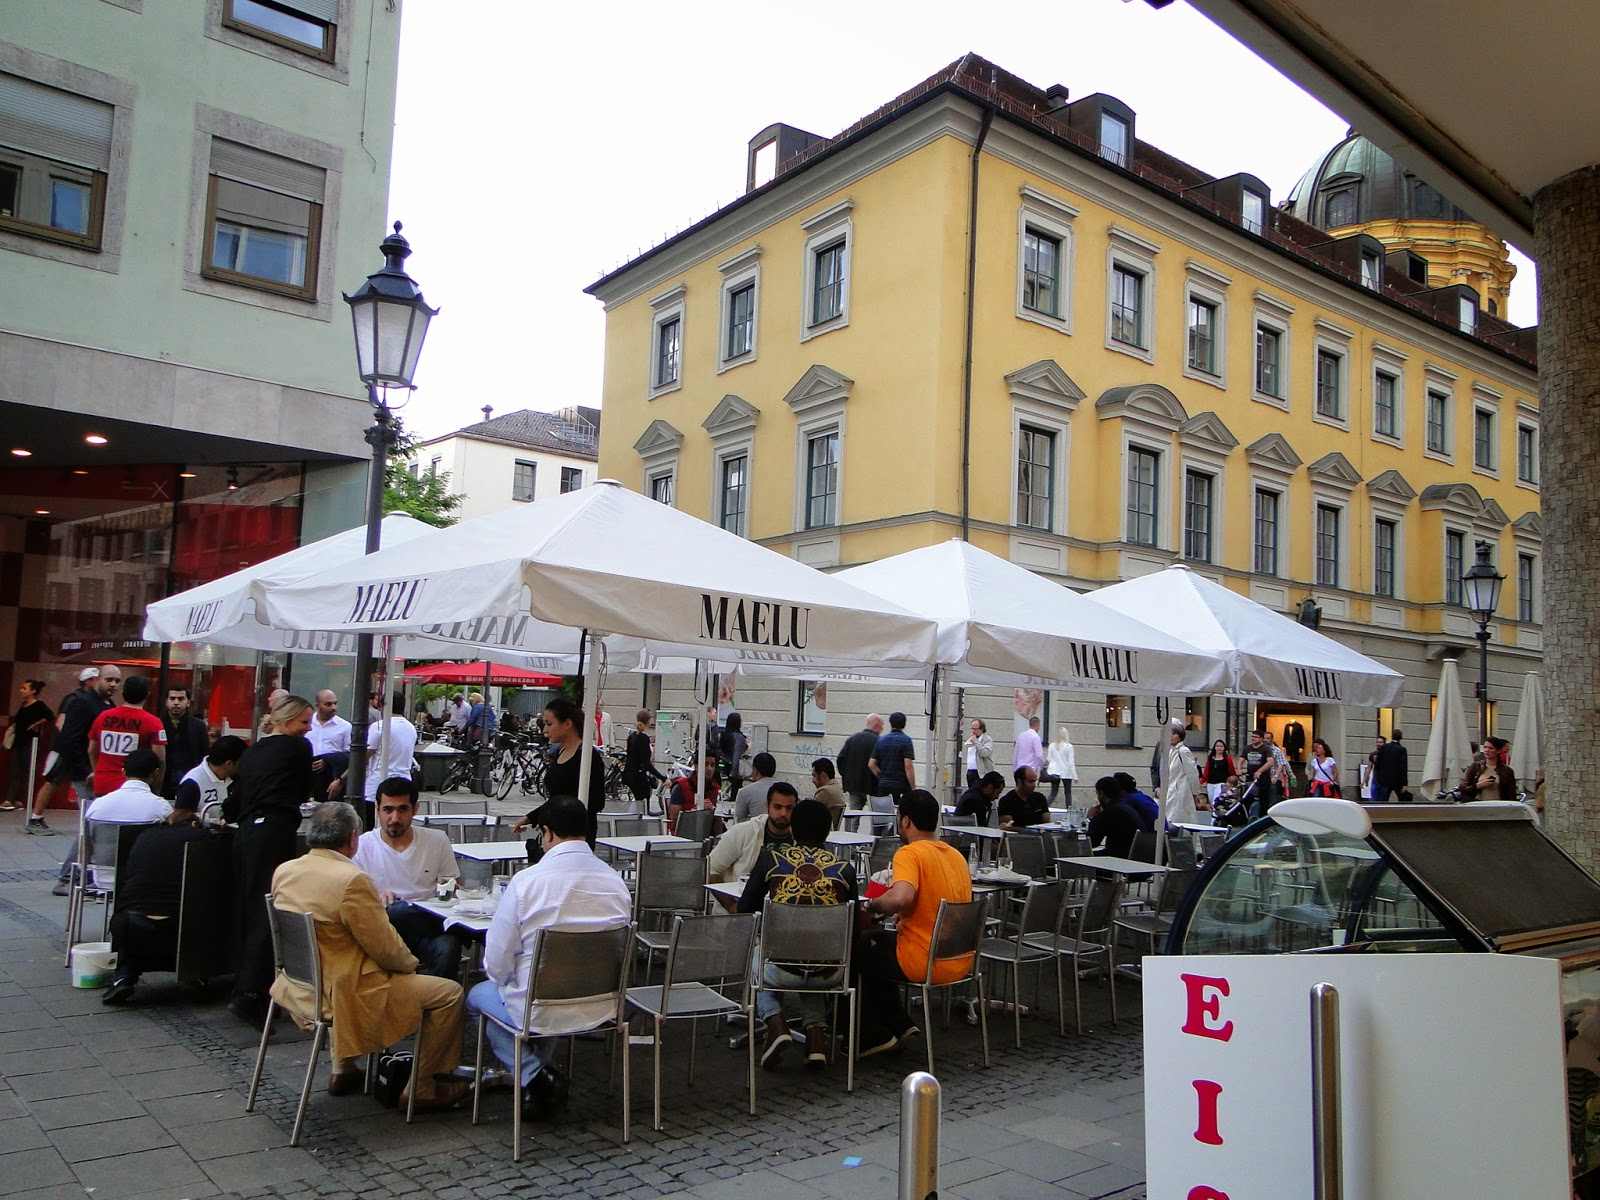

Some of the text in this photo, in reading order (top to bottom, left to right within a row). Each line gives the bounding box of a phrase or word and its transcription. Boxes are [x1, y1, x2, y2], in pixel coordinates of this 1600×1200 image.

[342, 578, 429, 624] MAELU
[699, 593, 811, 649] MAELU
[1069, 642, 1139, 684] MAELU
[1295, 667, 1342, 701] MAELU
[103, 715, 142, 731] SPAIN
[103, 733, 134, 754] 012
[204, 788, 219, 804] 23
[1180, 973, 1234, 1200] EI
